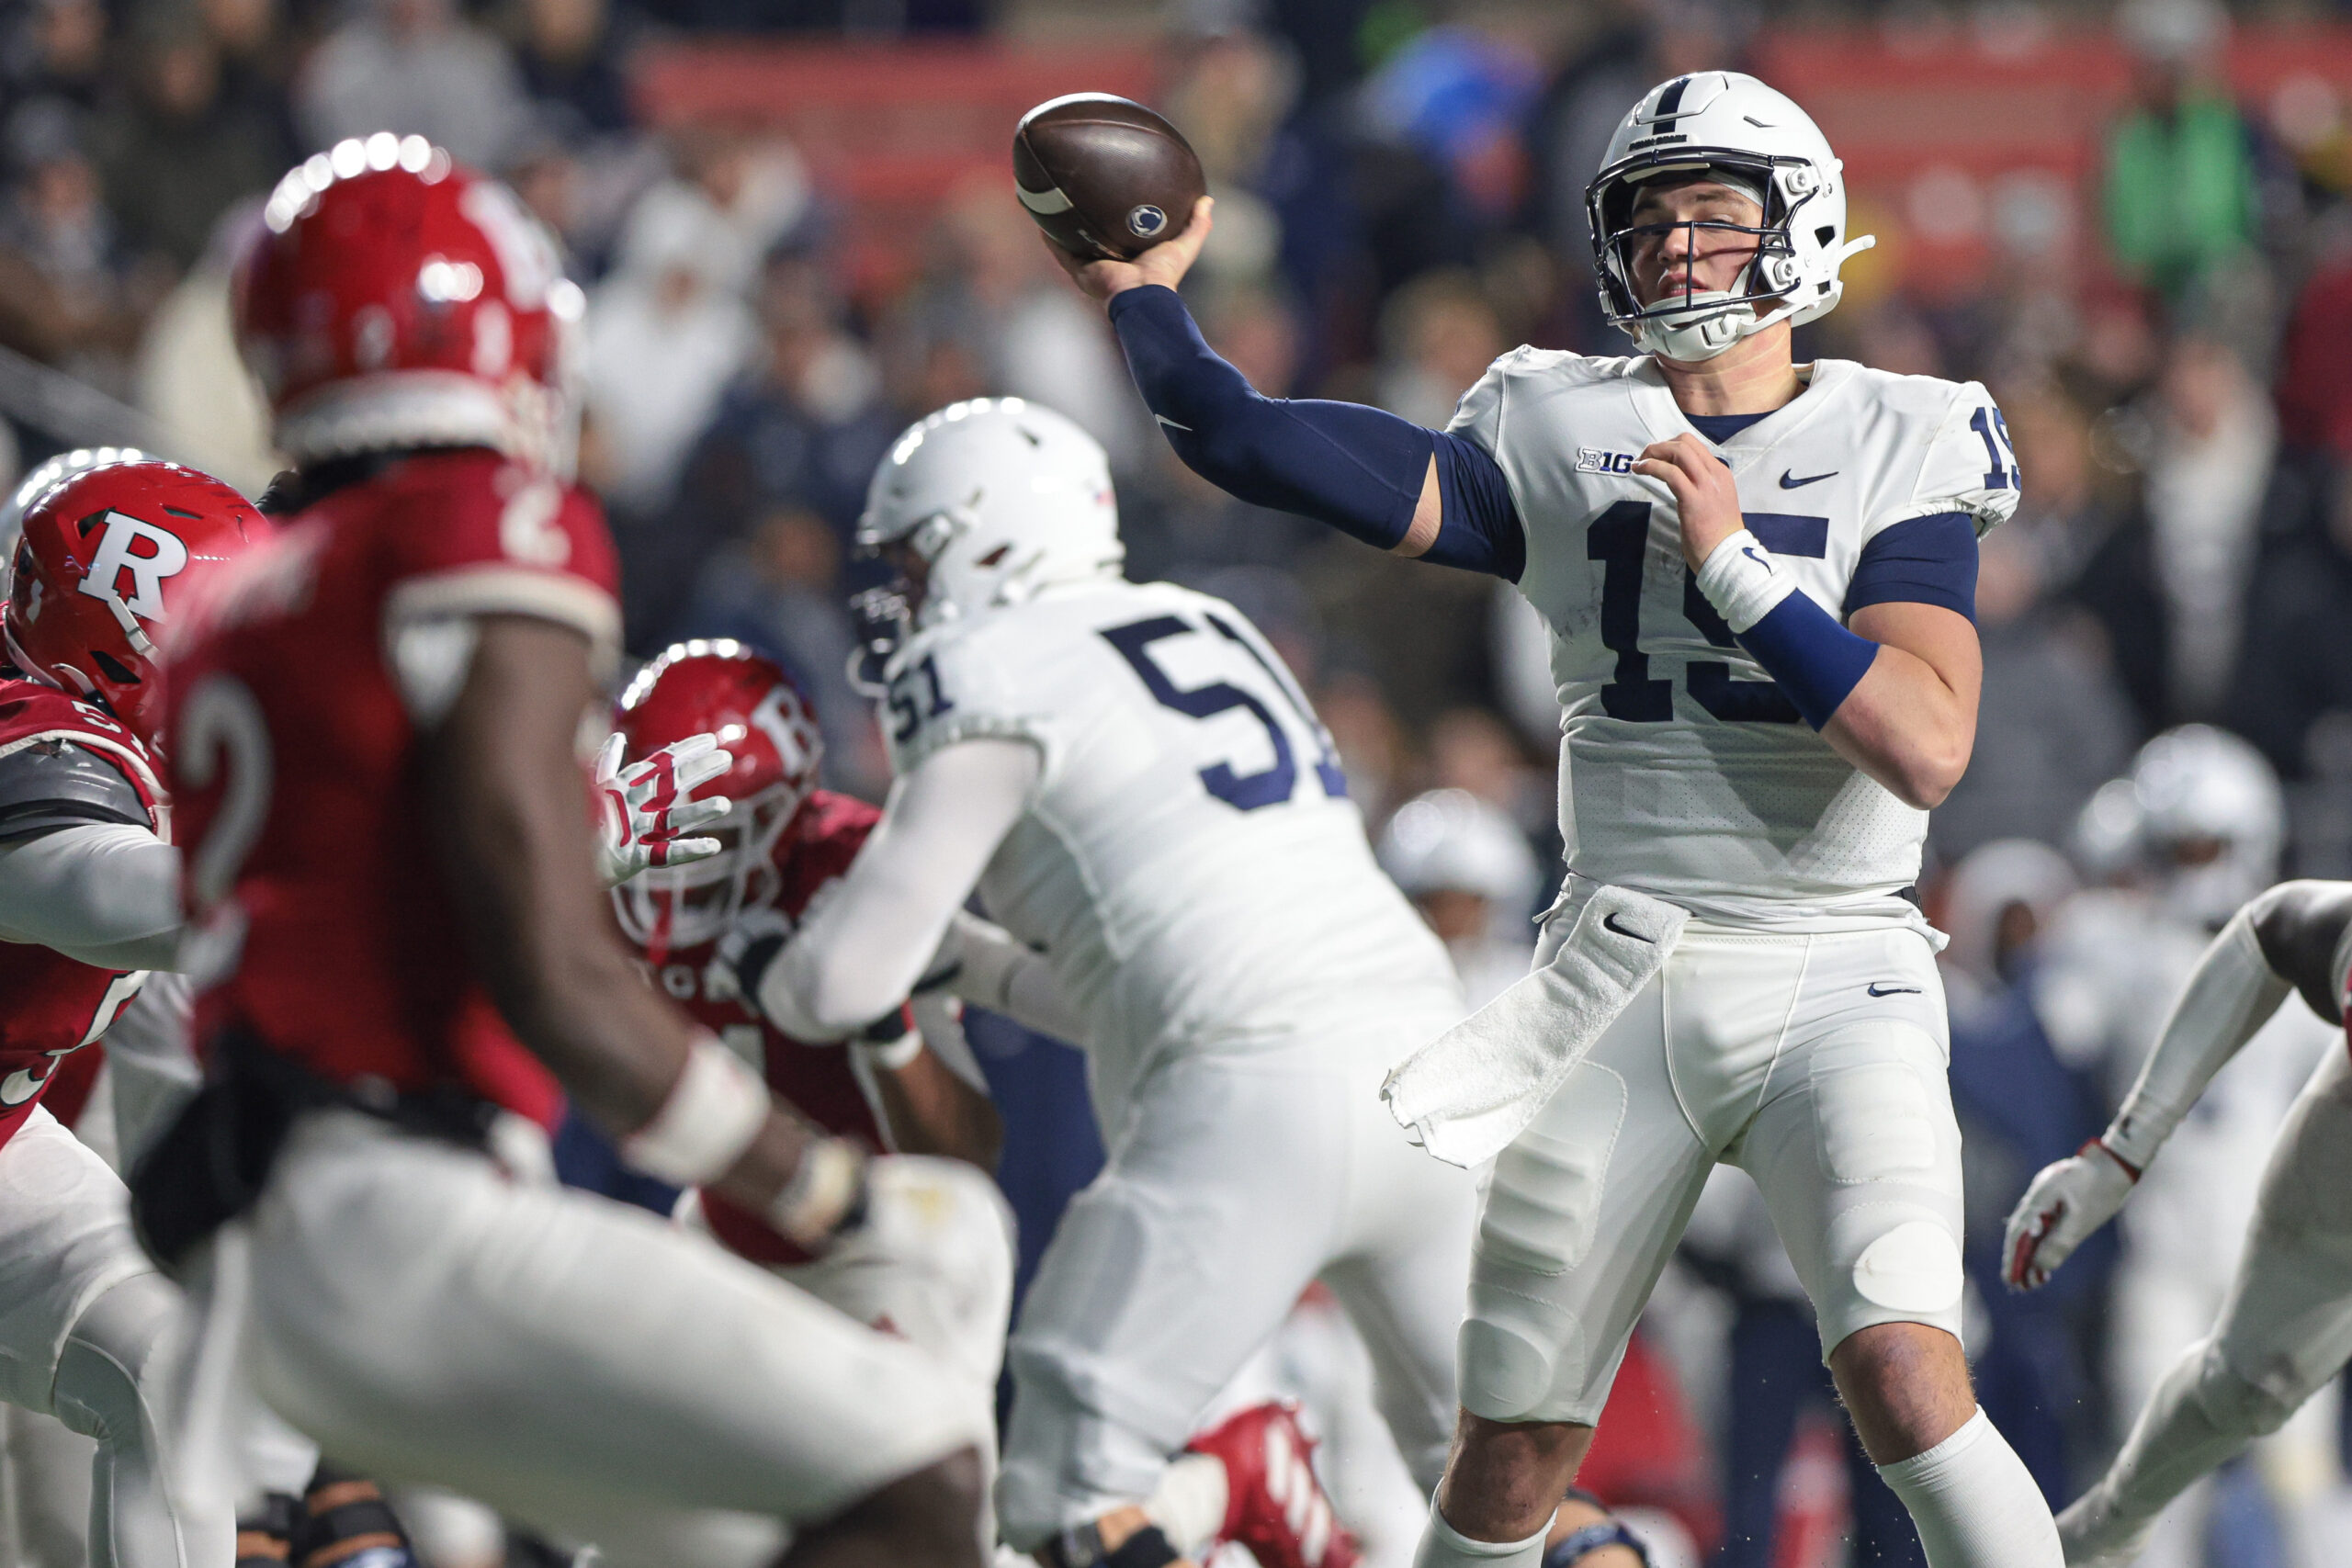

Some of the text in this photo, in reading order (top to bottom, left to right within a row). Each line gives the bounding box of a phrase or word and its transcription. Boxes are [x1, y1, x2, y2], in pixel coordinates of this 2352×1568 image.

[77, 508, 188, 626] R
[1586, 500, 1830, 724] 15
[888, 652, 953, 744] 51
